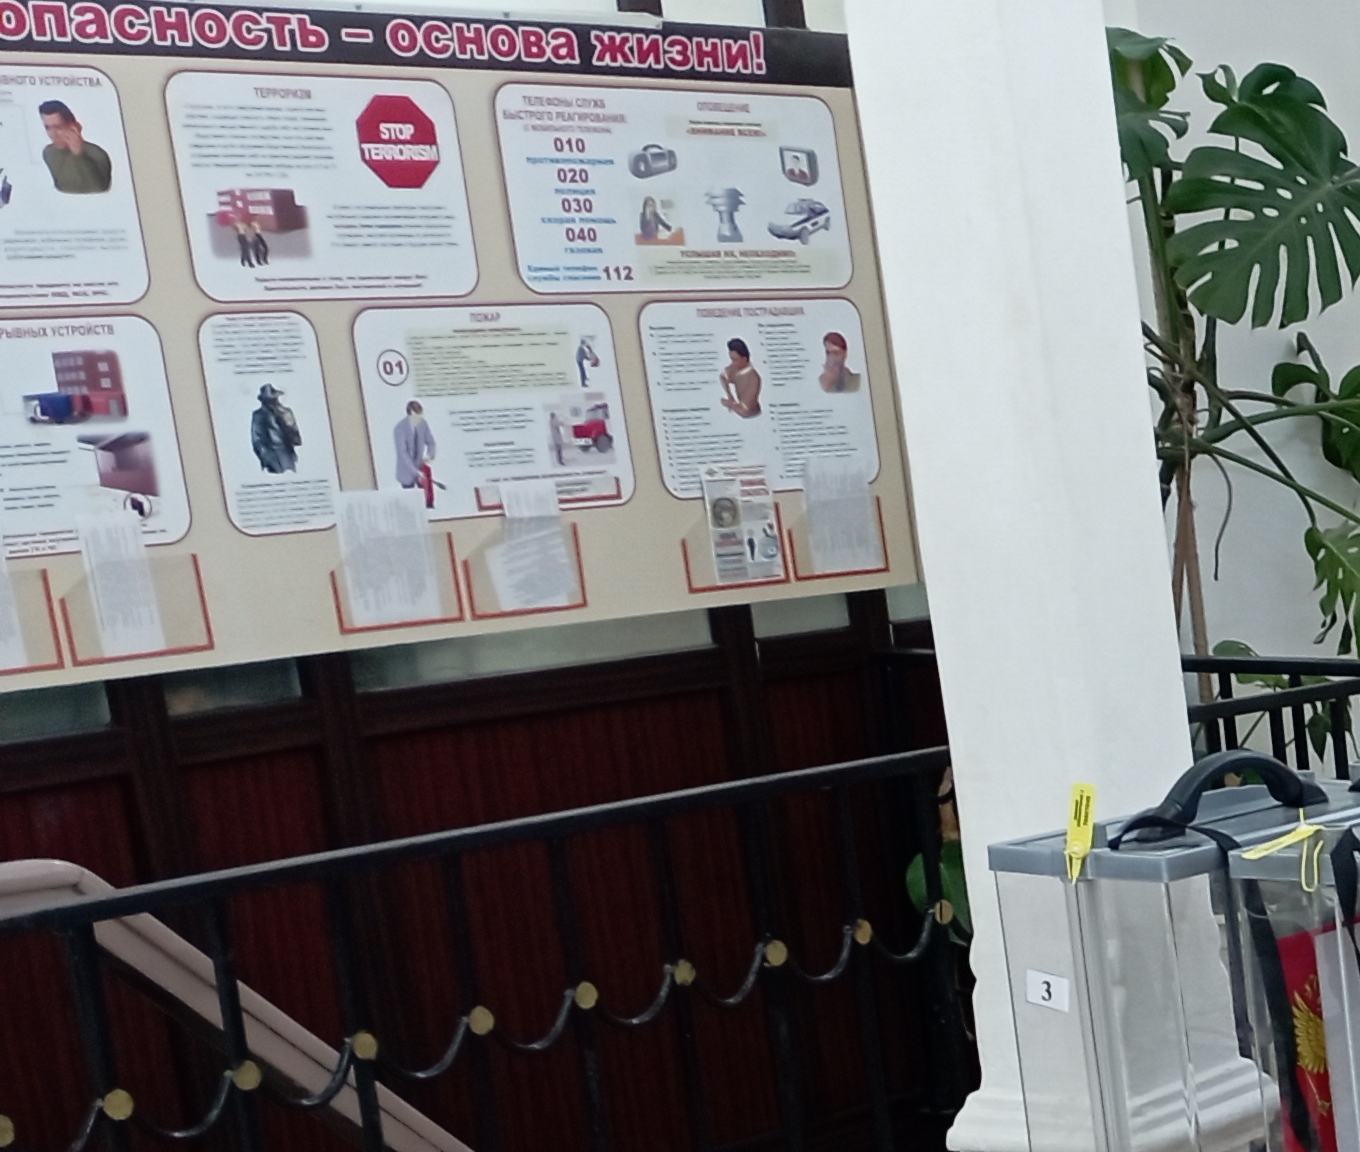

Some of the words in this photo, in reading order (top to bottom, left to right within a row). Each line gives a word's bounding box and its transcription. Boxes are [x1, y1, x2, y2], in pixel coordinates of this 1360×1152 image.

[0, 0, 329, 52] опасность
[386, 18, 580, 63] основа
[591, 29, 767, 74] жизни!
[39, 75, 102, 87] УСТРОЙСТВА
[253, 87, 312, 99] ТЕРРОРИЗМ
[522, 95, 573, 107] ТЕЛЕФОНЫ
[575, 97, 606, 109] СЛУЖБ
[502, 109, 554, 121] БЫСТРОГО
[379, 122, 415, 140] STOP
[361, 143, 439, 161] TERRORISM
[553, 137, 586, 153] 010
[557, 167, 589, 183] 020
[561, 198, 593, 213] 030
[565, 227, 597, 242] 040
[602, 265, 634, 281] 112
[470, 312, 501, 322] ПОЖАР
[52, 323, 115, 337] УСТРОЙСТВ
[383, 360, 404, 375] 01
[1041, 980, 1052, 1002] 3
